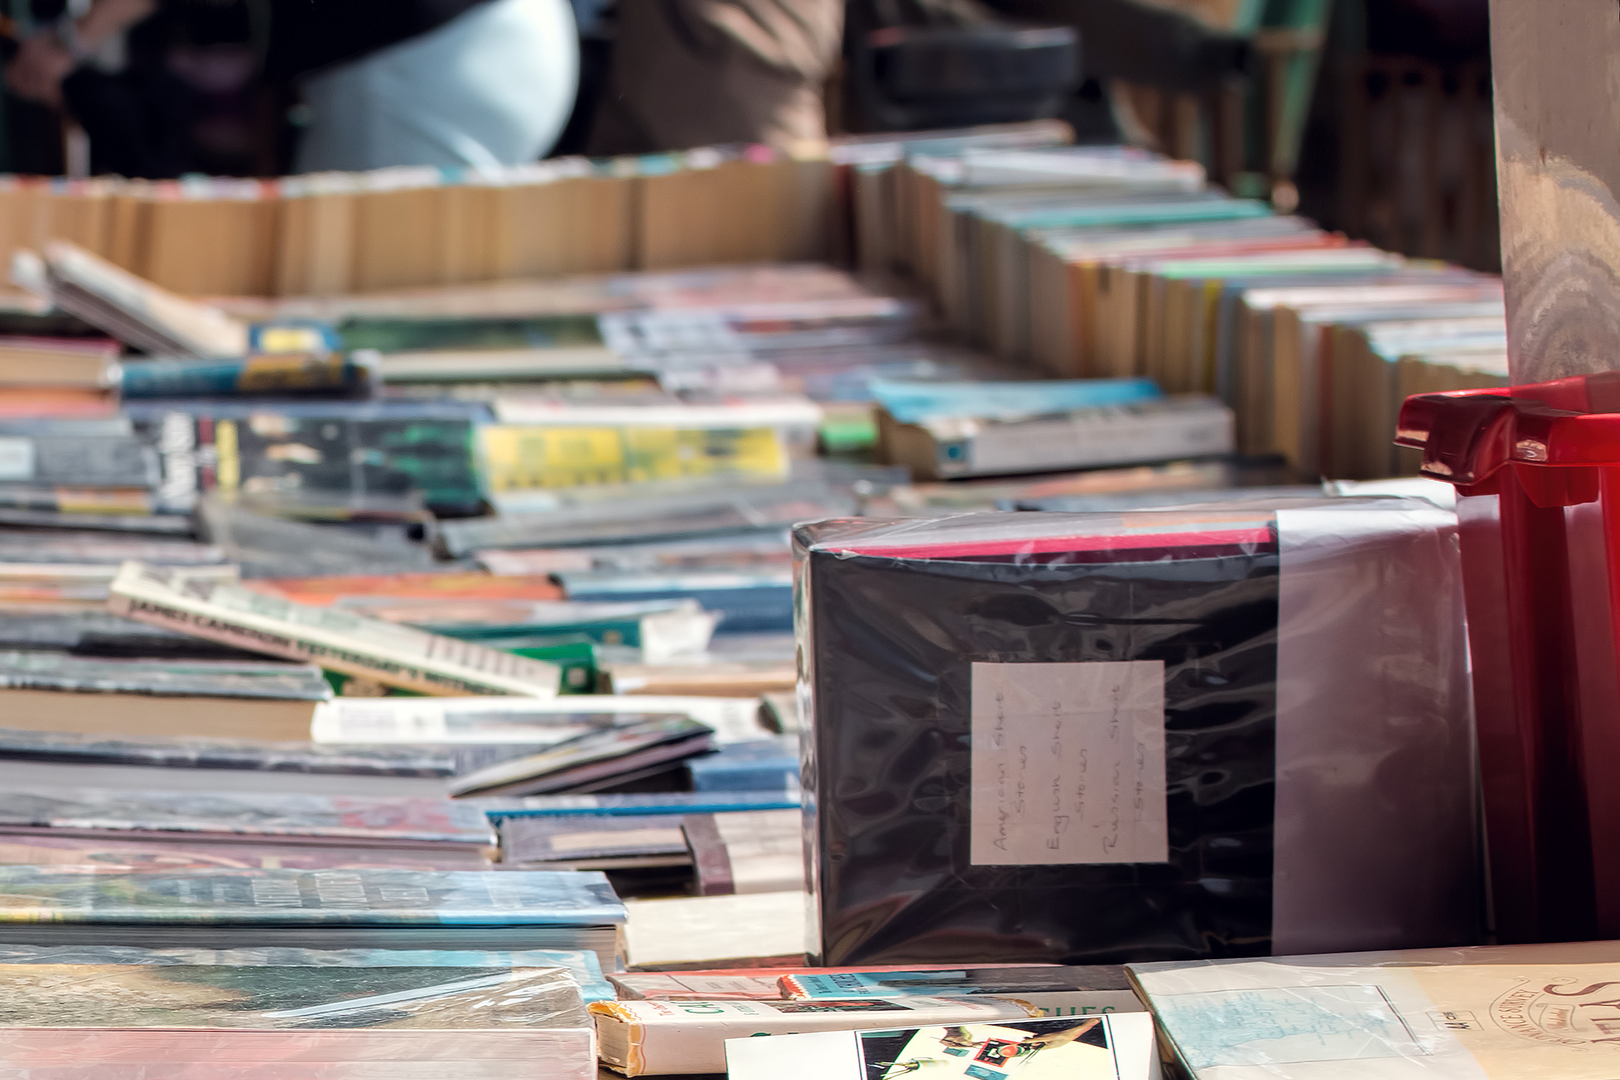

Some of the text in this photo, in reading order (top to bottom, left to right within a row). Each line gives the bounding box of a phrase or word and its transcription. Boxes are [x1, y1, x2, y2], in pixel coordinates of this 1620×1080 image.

[992, 762, 1008, 851] American
[1498, 988, 1541, 1014] SURVEY
[1499, 1013, 1587, 1046] ORDNANCE
